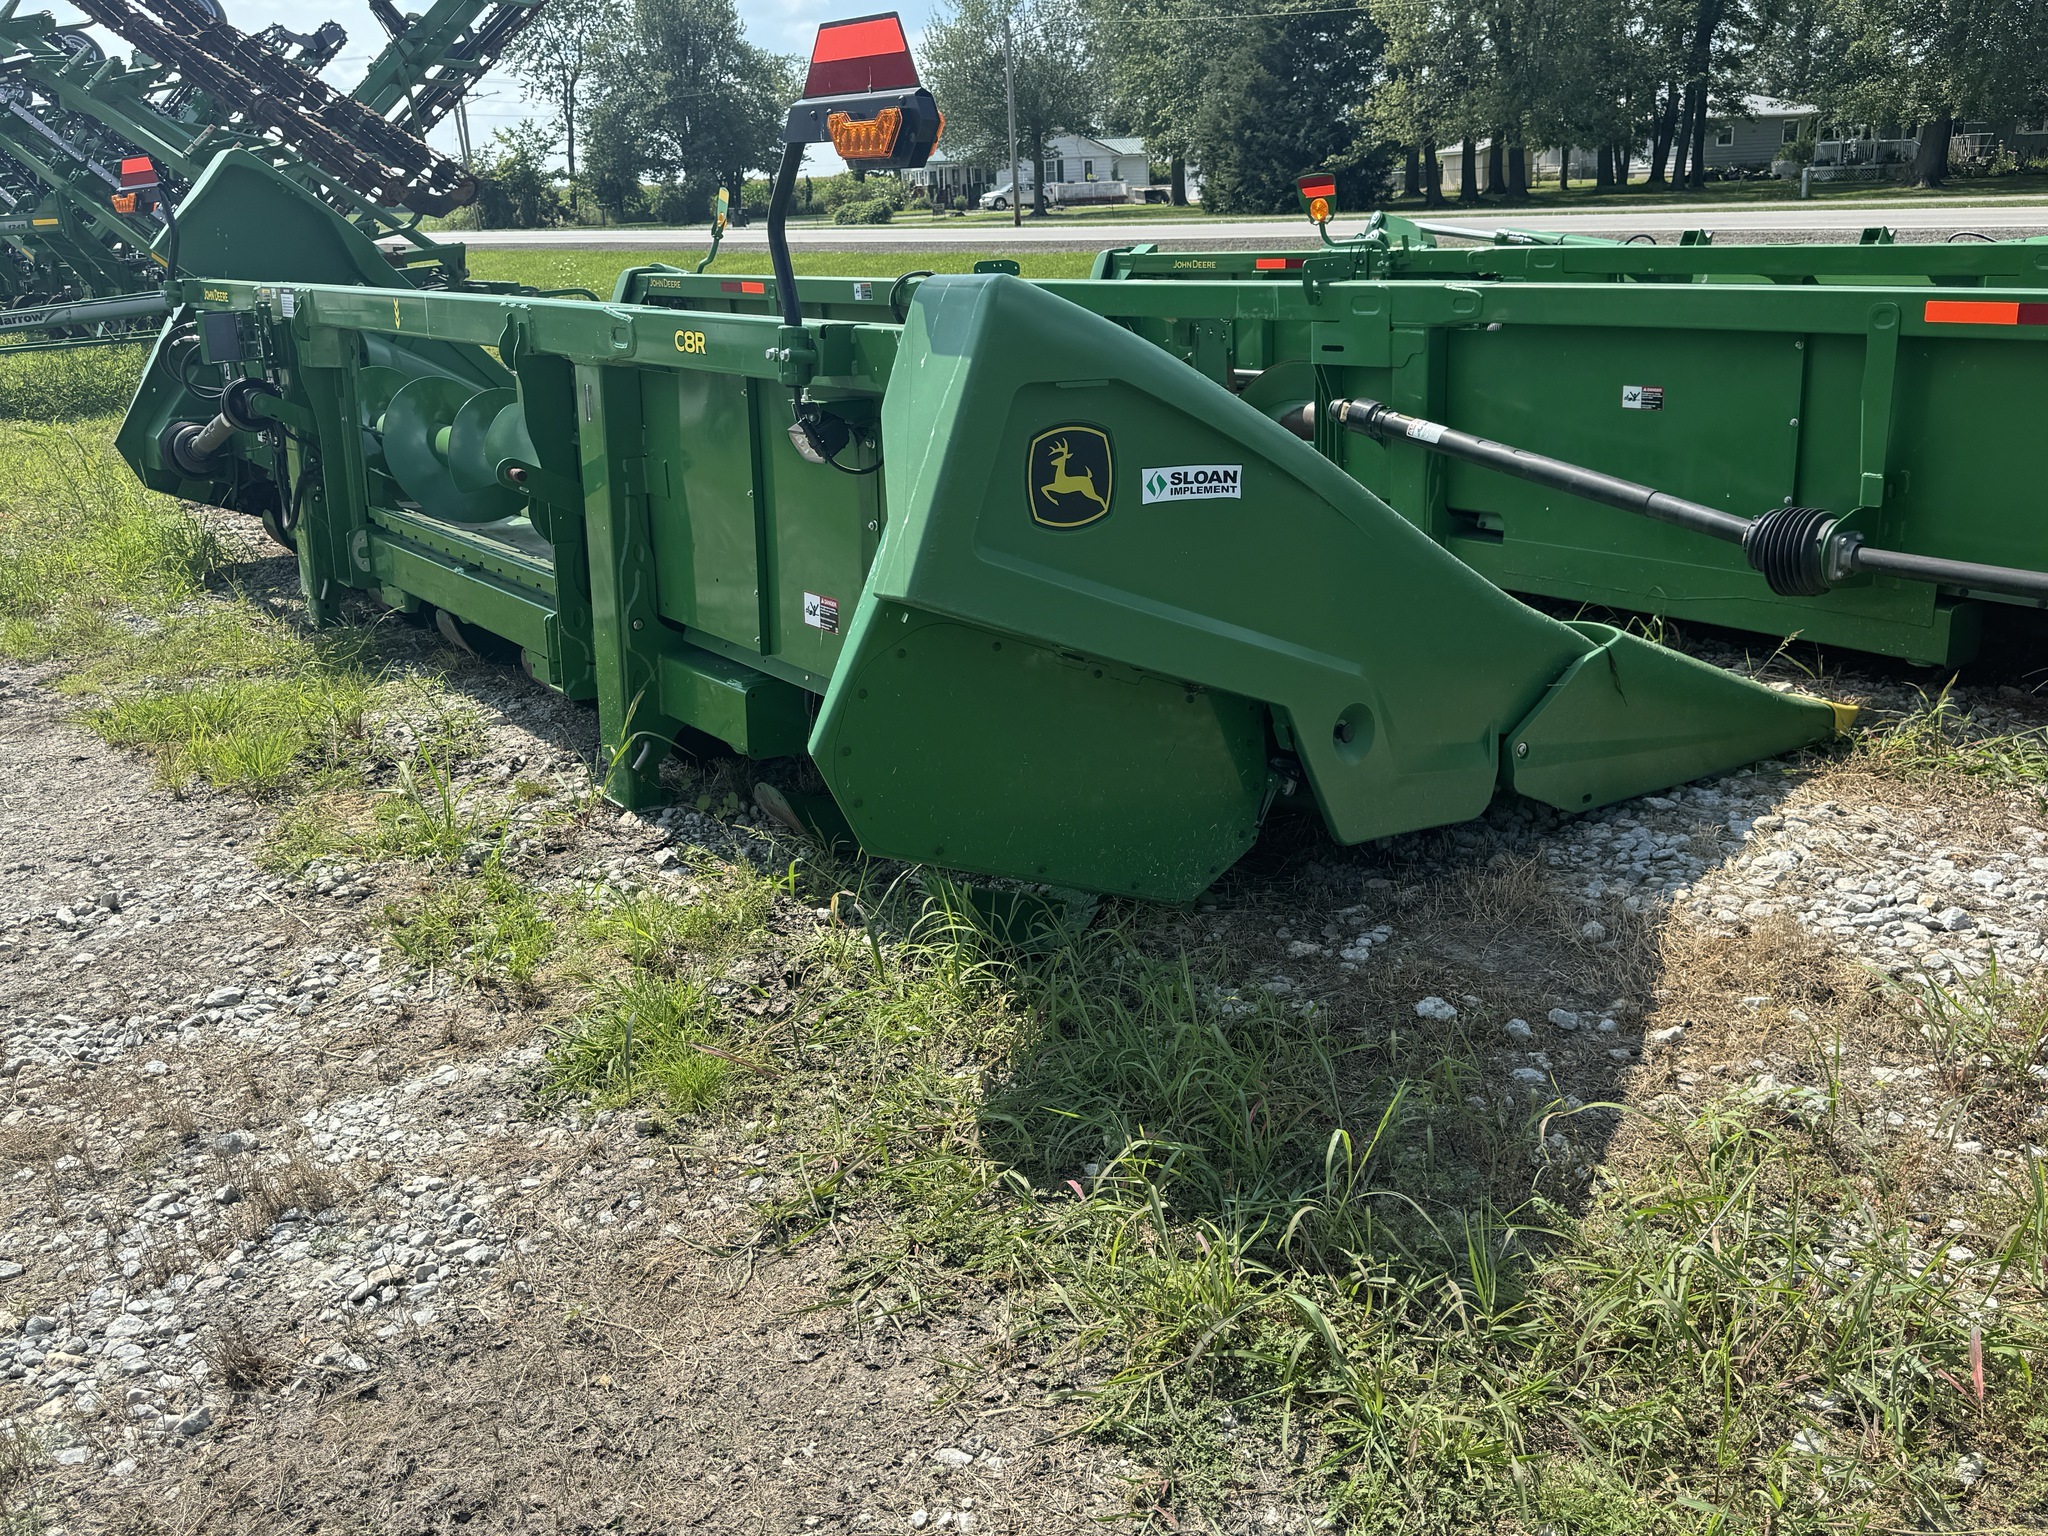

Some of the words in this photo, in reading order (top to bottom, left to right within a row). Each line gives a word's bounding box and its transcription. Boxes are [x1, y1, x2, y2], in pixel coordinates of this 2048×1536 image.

[1173, 260, 1192, 269] JOHN
[1192, 260, 1217, 269] DEERE
[650, 278, 664, 287] JOHN
[663, 278, 681, 288] DEERE
[204, 288, 215, 300] JOHN
[214, 289, 229, 302] DEERE
[674, 330, 707, 355] C8R
[1170, 470, 1238, 486] SLOAN
[1170, 485, 1238, 496] IMPLEMENT
